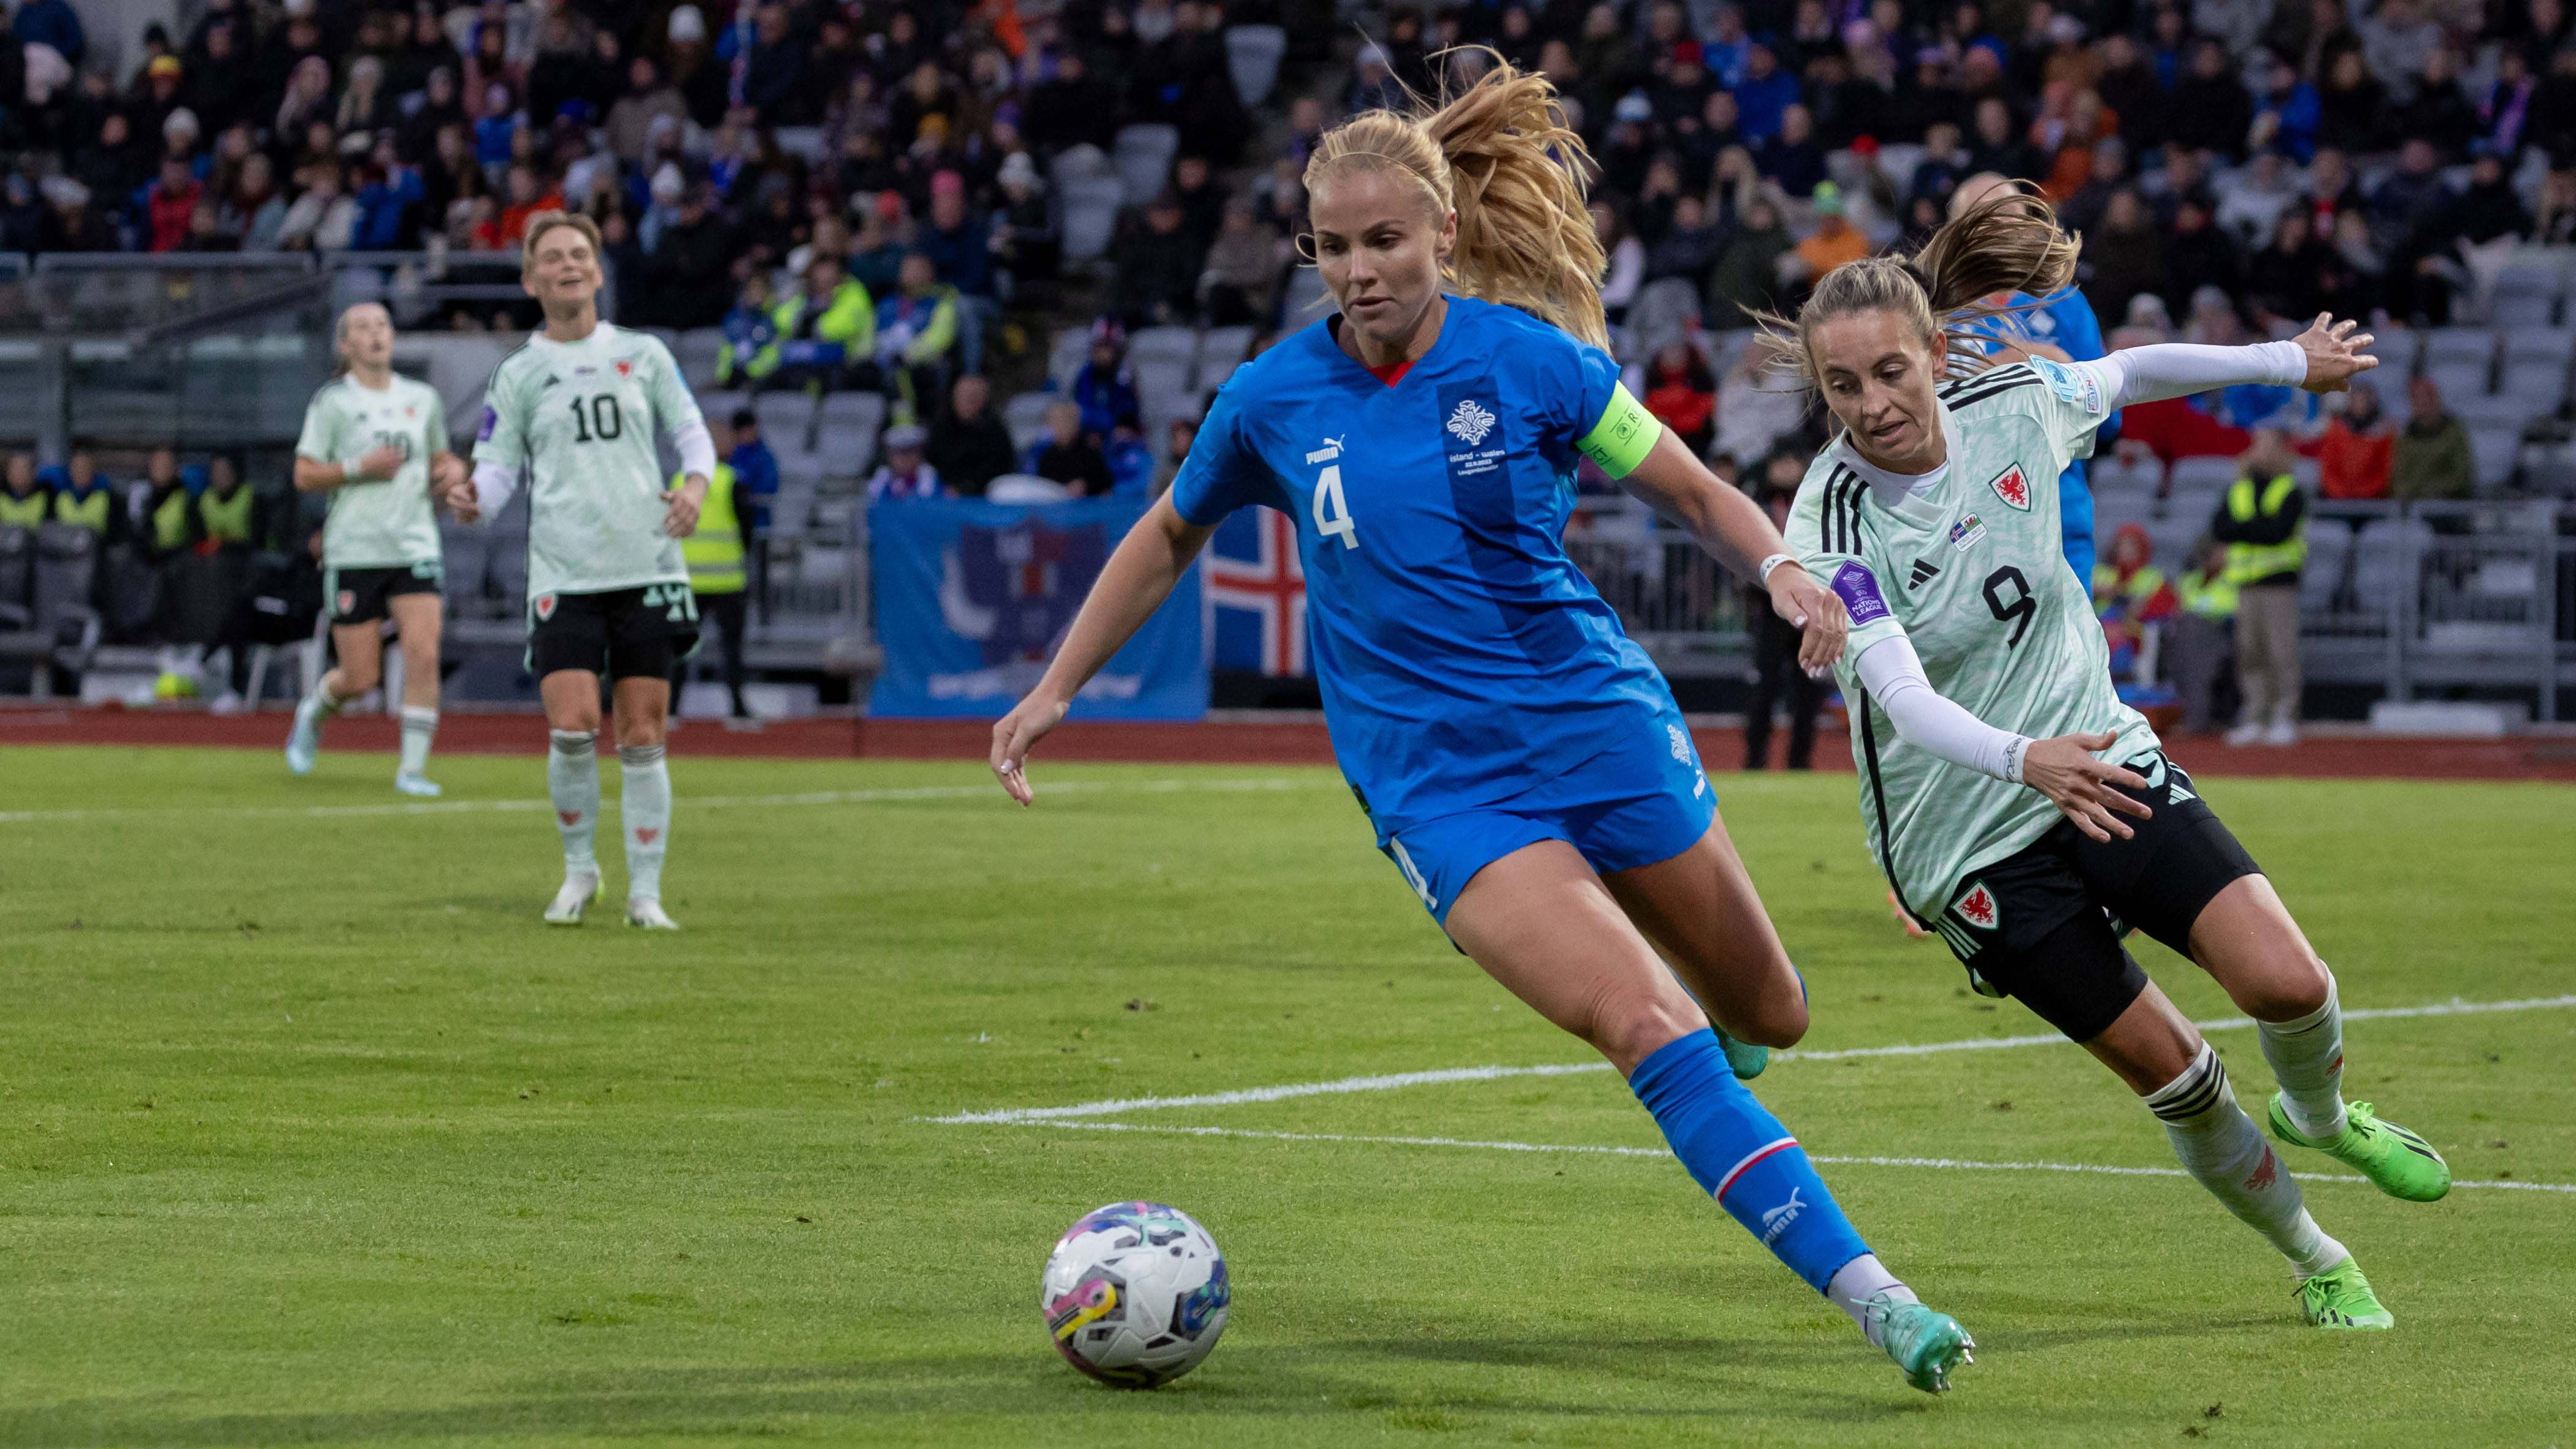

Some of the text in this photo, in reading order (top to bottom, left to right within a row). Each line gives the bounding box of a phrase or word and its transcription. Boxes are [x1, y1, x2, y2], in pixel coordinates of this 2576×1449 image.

[570, 394, 619, 442] 10
[1313, 464, 1360, 550] 4
[1852, 599, 1881, 612] NATIONS
[1855, 604, 1883, 617] LEAGUE
[1982, 565, 2036, 651] 9
[1390, 836, 1438, 909] 4
